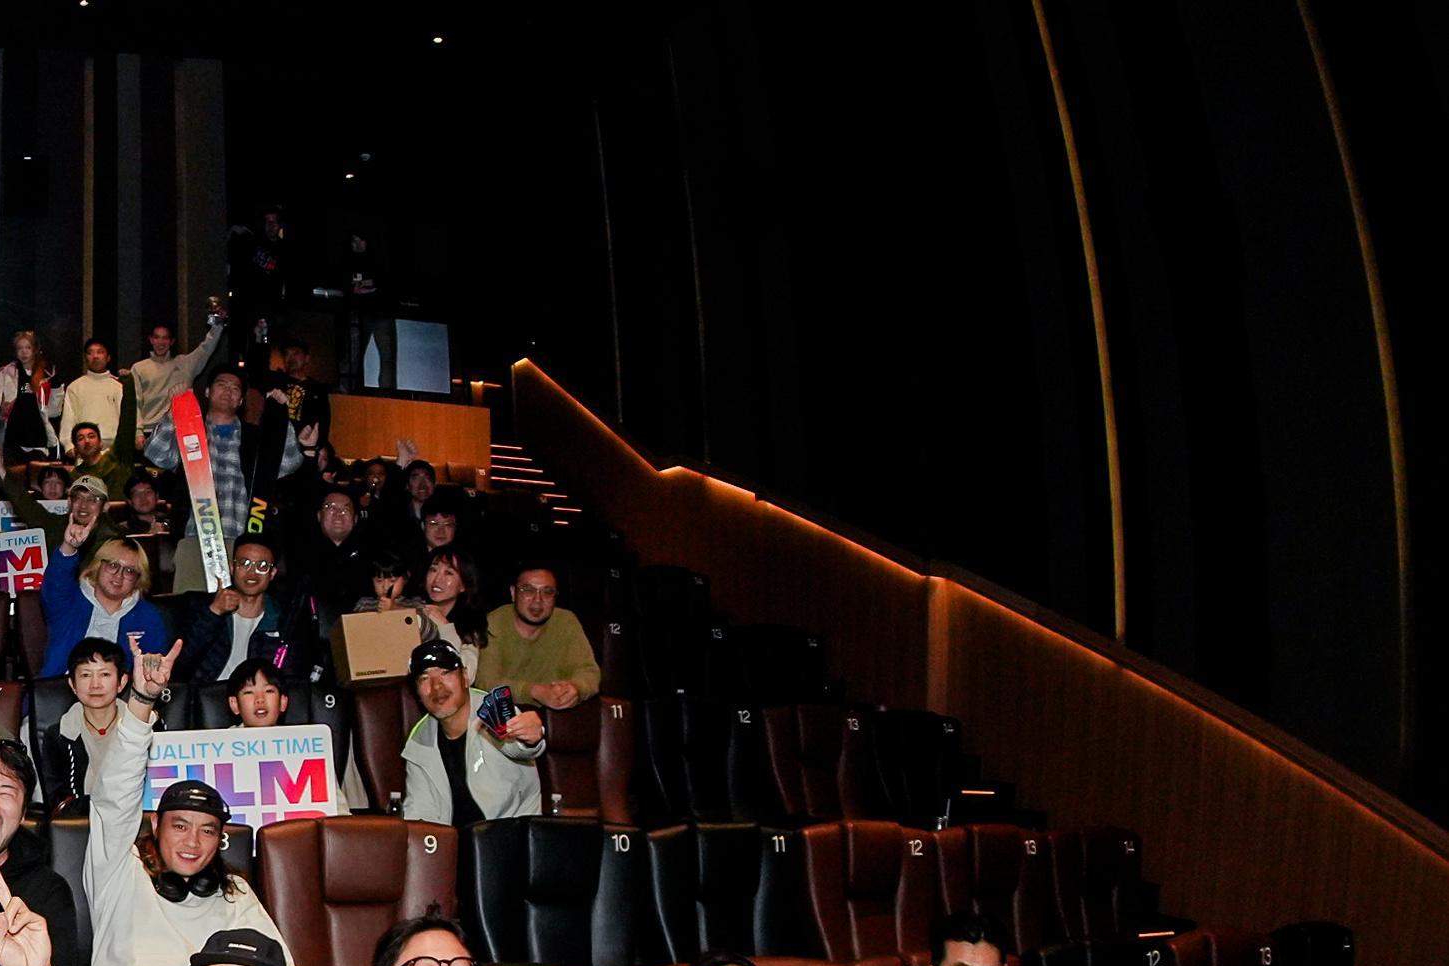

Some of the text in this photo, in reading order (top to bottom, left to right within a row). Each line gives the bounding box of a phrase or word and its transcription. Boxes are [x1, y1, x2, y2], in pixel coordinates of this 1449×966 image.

[7, 535, 39, 547] TIME
[160, 688, 171, 702] 8
[324, 692, 336, 709] 9
[611, 704, 623, 718] 11
[737, 709, 751, 724] 12
[149, 737, 325, 761] UALITY SKI TIME
[424, 834, 438, 855] 9
[611, 833, 631, 854] 10
[771, 833, 787, 854] 11
[908, 839, 925, 856] 12
[1023, 839, 1038, 856] 13
